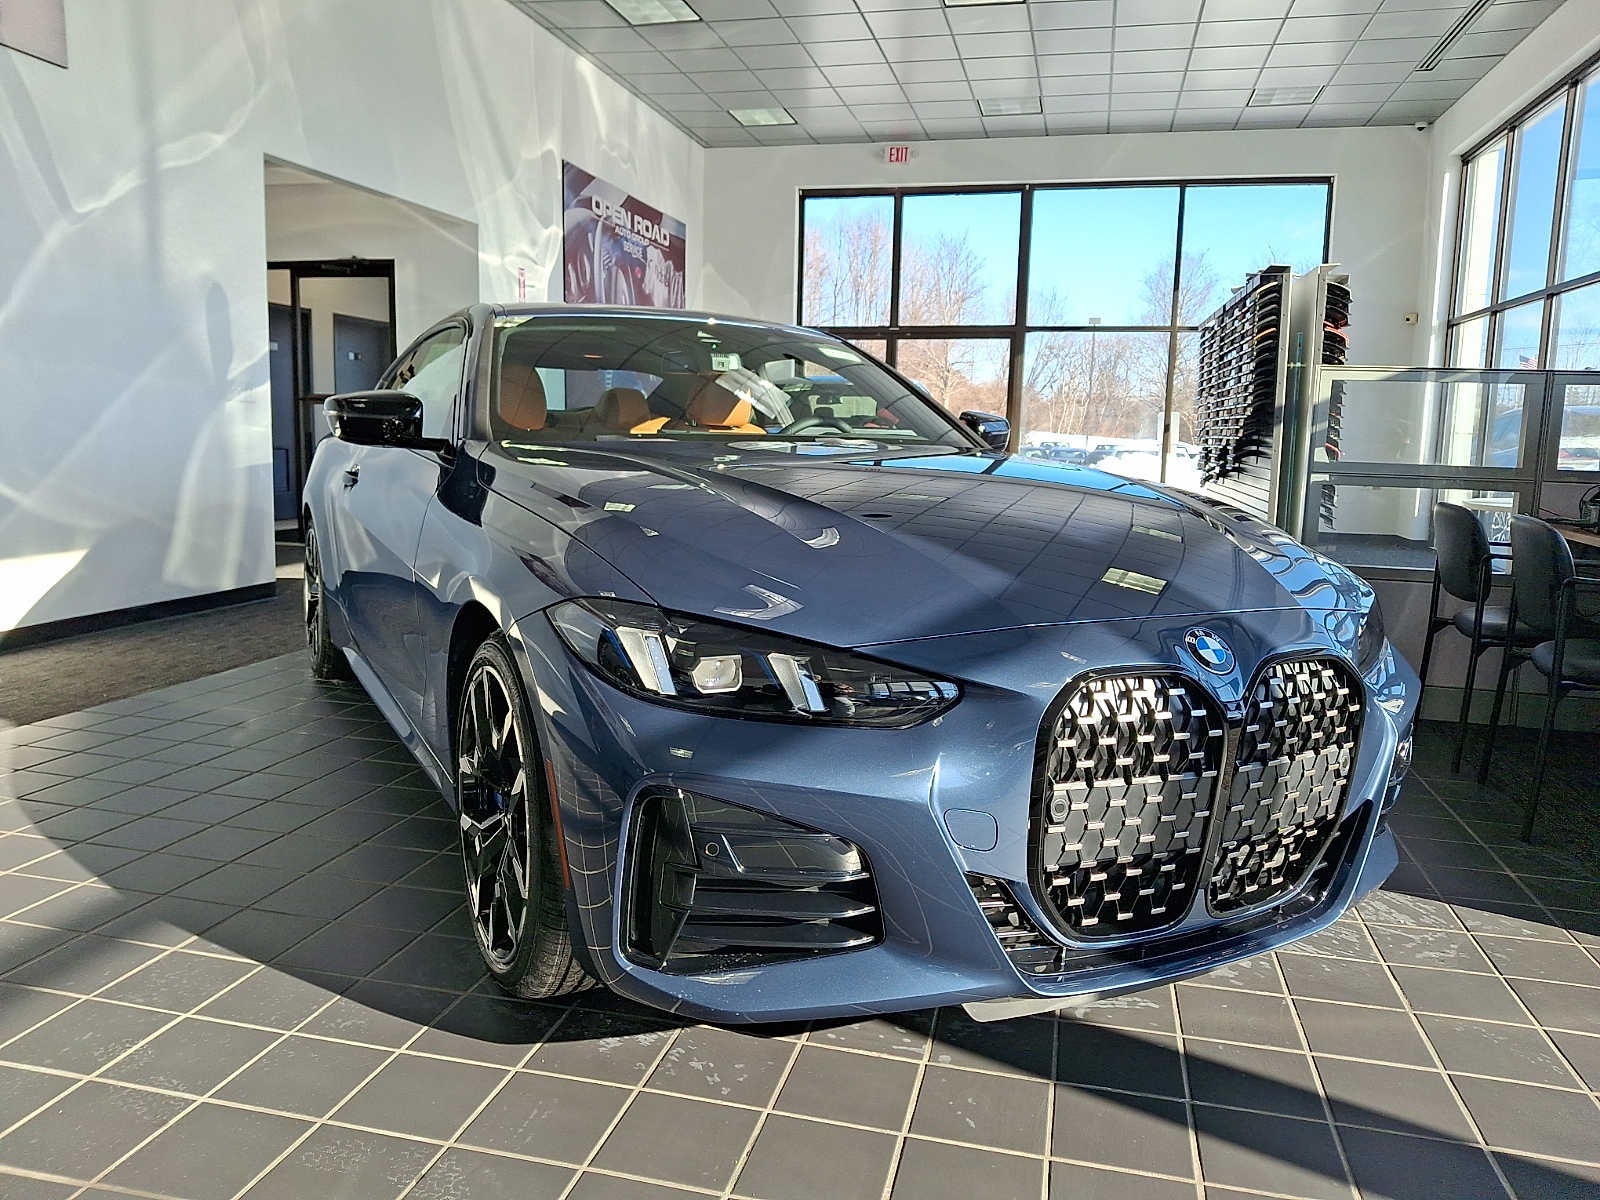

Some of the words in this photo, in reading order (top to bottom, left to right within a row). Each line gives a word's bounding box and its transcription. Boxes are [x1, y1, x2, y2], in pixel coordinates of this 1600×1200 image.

[889, 146, 909, 162] EXIT
[591, 195, 632, 230] OPEN
[633, 214, 670, 247] ROAD
